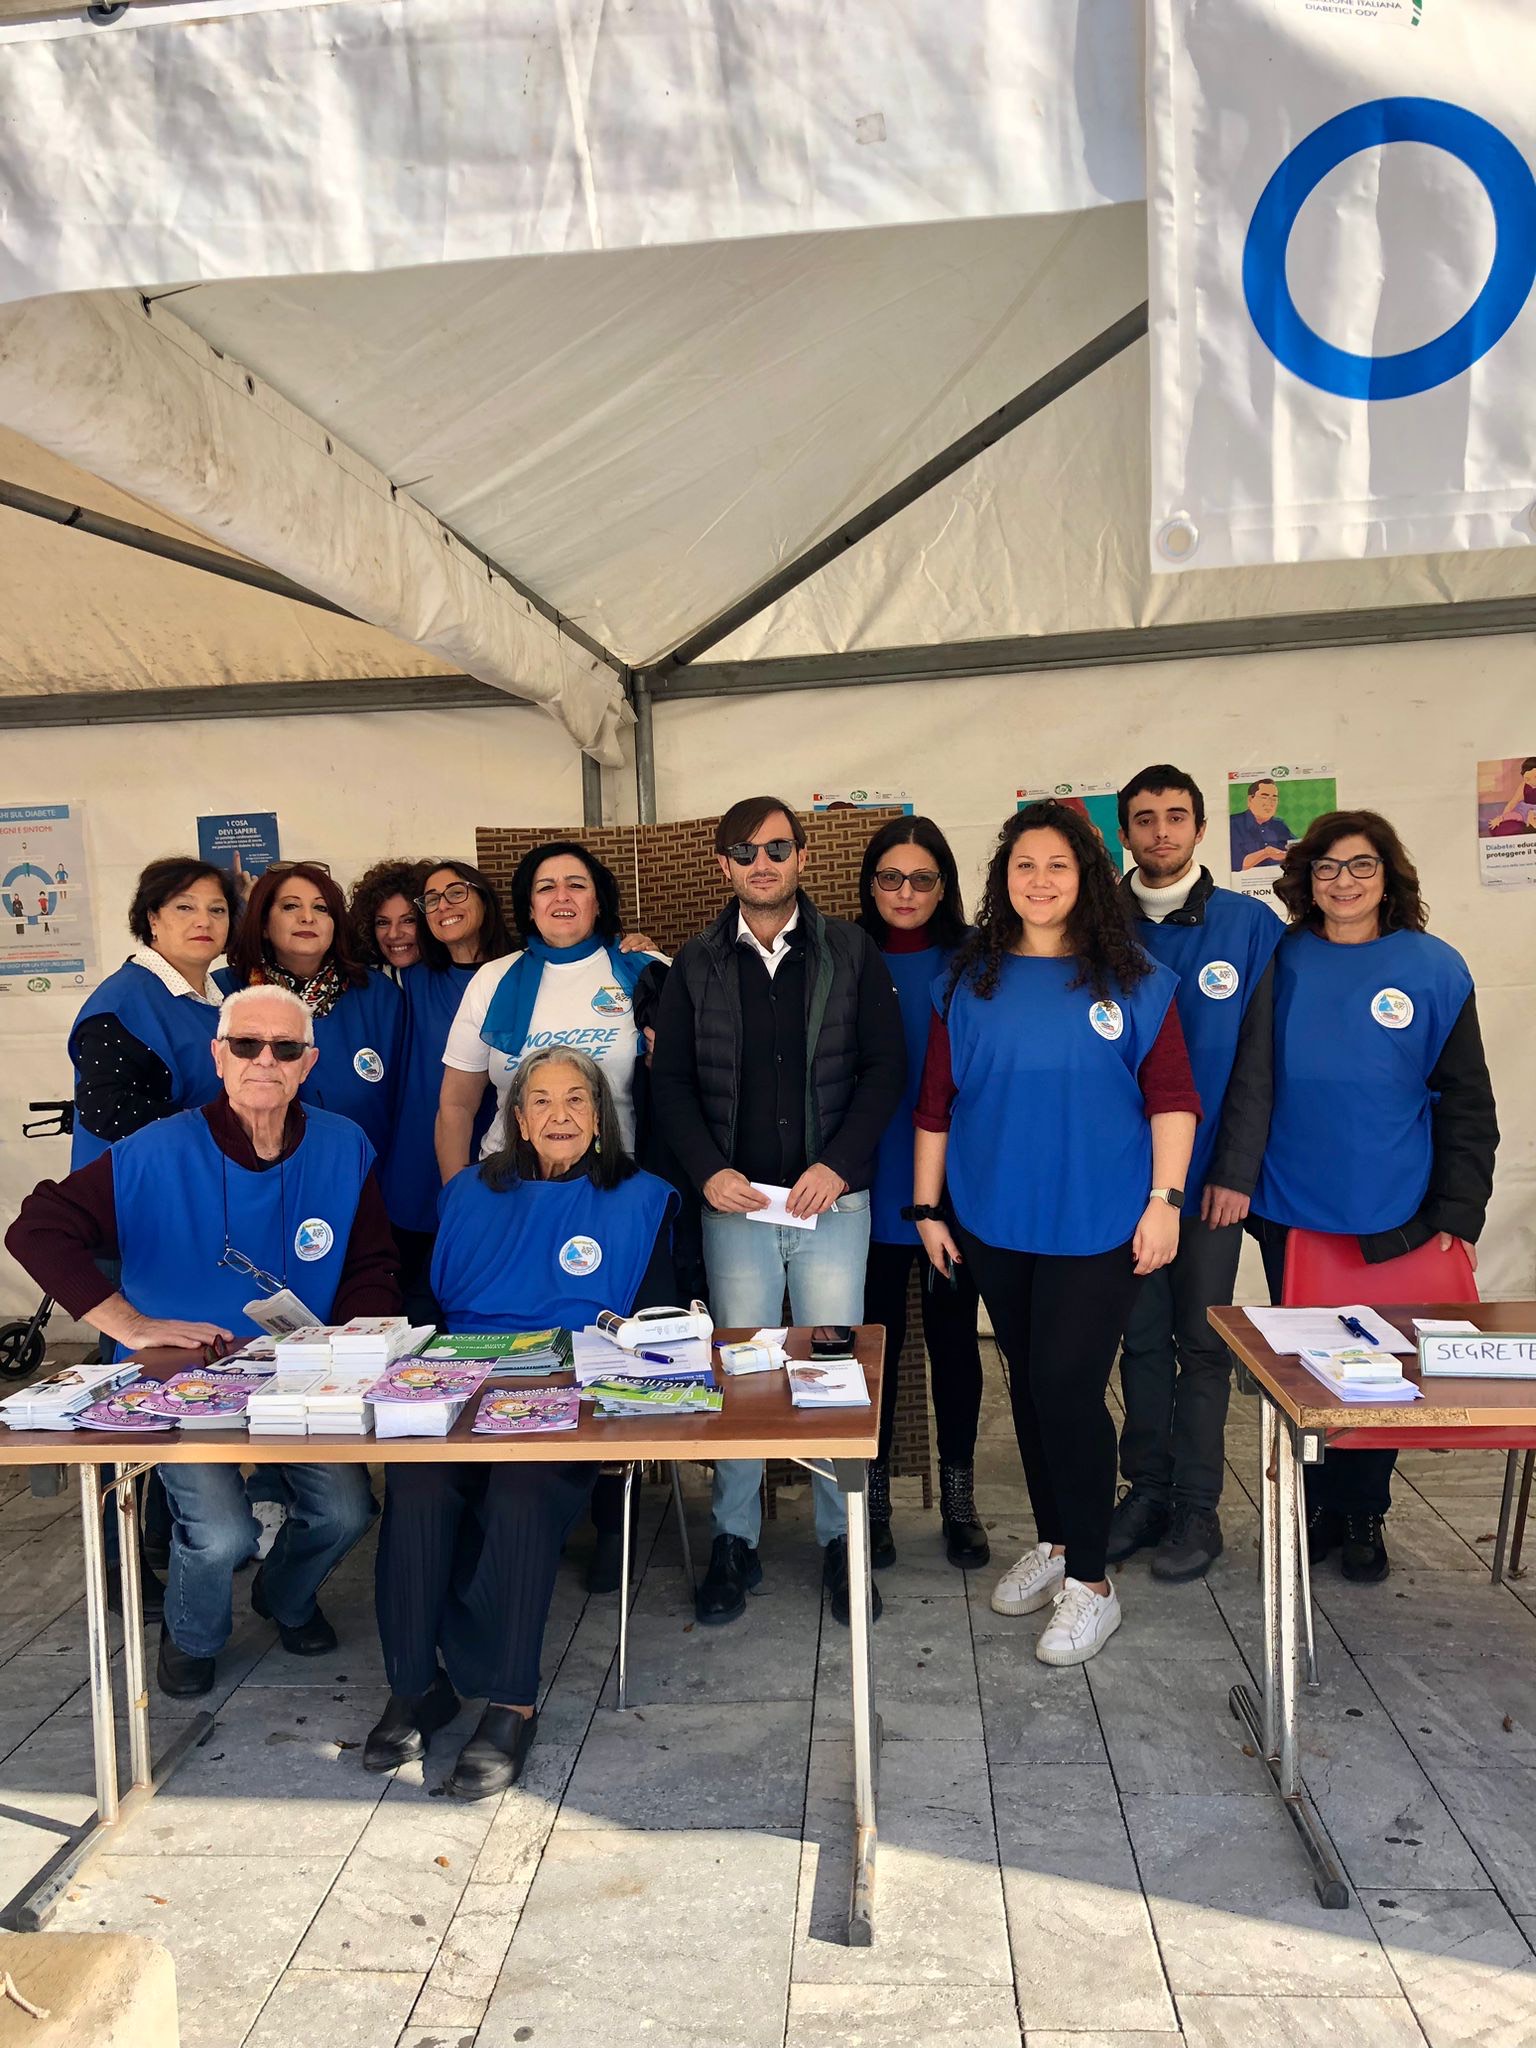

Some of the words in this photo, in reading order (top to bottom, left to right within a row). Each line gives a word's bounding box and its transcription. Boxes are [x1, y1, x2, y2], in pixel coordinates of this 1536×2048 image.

[1357, 0, 1402, 9] ITALIANA
[1305, 3, 1352, 14] DIABETICI
[1355, 9, 1378, 17] ODV
[25, 809, 56, 817] DIABETE
[23, 825, 53, 834] SINTOMI
[218, 828, 233, 836] DEVI
[234, 827, 257, 835] SAPERE
[1486, 843, 1515, 851] Diabete:
[1487, 850, 1526, 860] proteggere
[526, 1028, 621, 1048] NOSCERE
